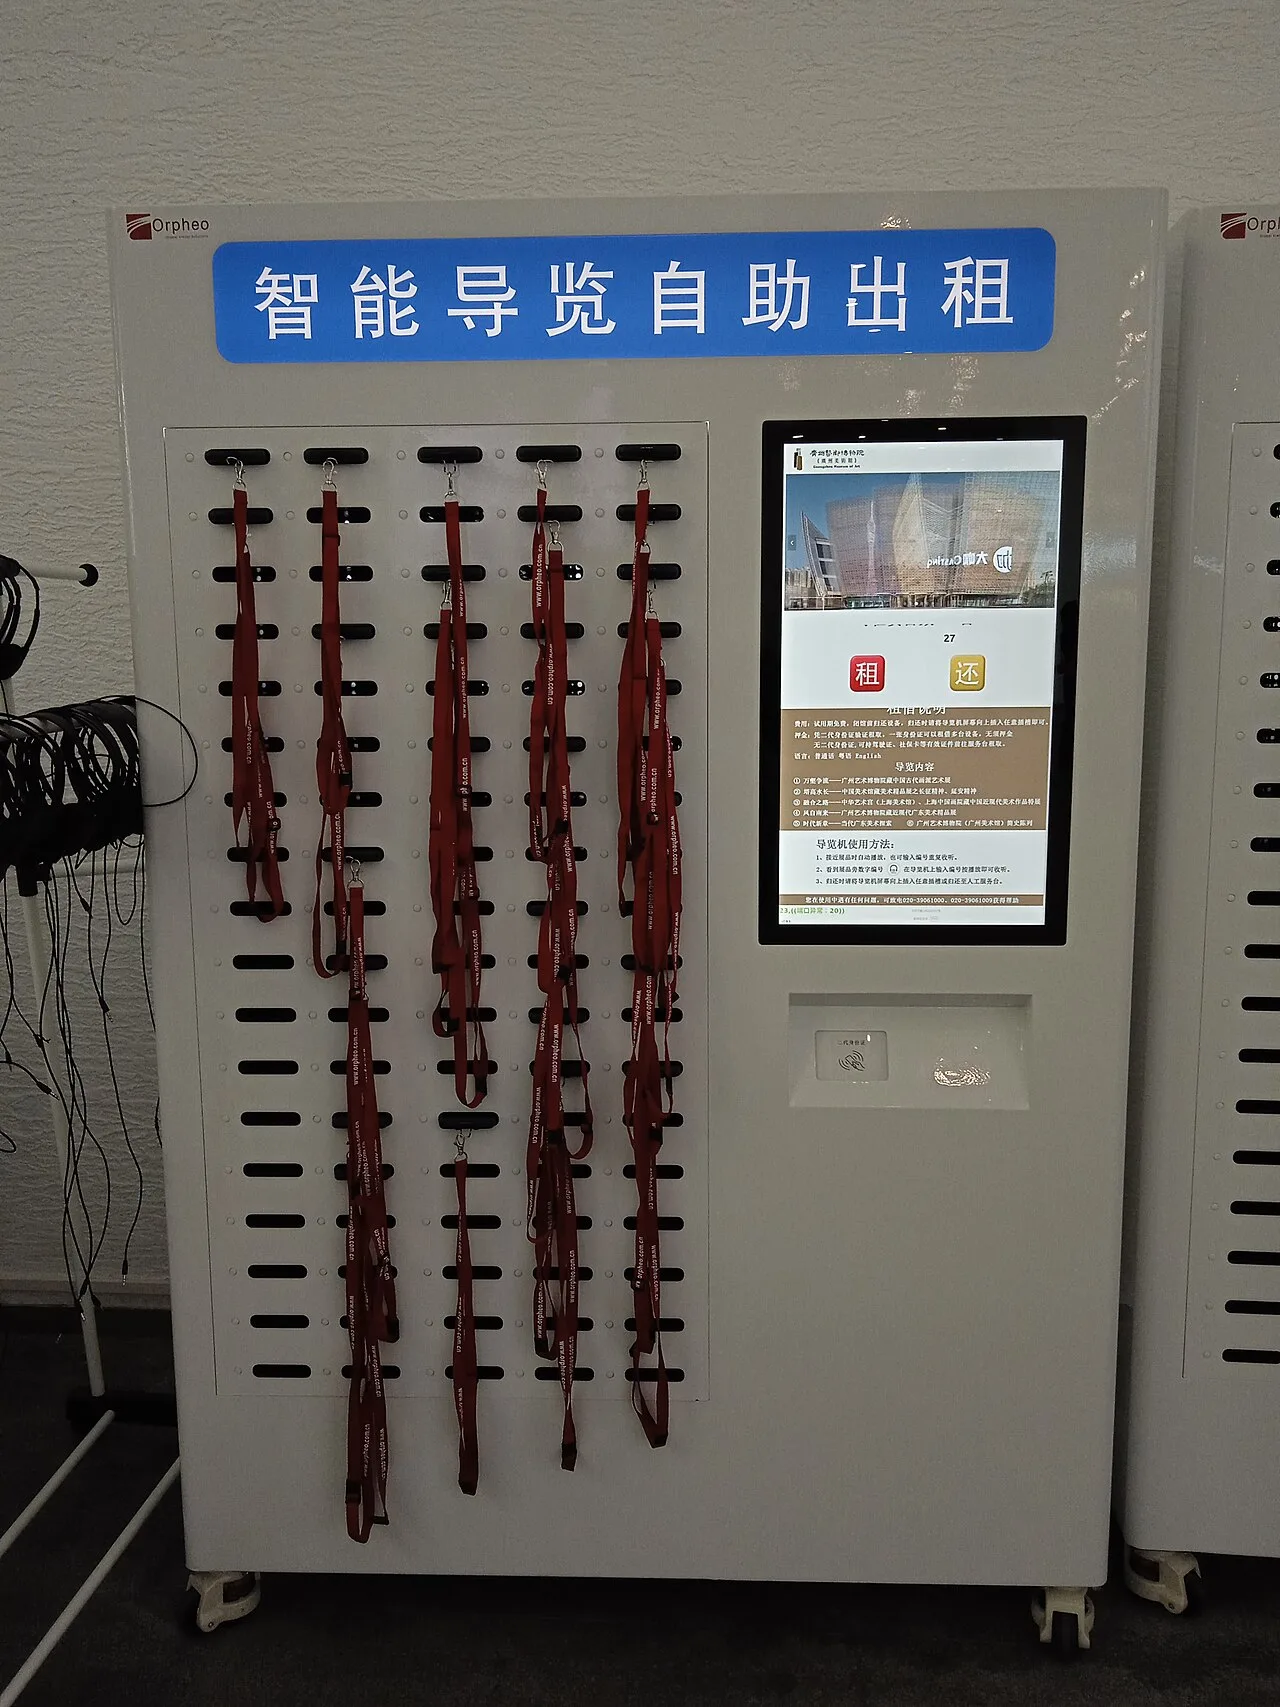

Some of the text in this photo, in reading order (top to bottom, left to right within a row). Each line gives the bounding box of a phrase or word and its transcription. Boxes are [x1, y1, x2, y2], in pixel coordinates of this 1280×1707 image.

[152, 217, 210, 235] Orpheo
[1246, 217, 1280, 234] Orp
[254, 256, 1014, 340] 智能导览自助出租
[943, 634, 955, 643] 27
[856, 661, 880, 687] 租
[955, 661, 980, 686] 还
[855, 752, 881, 760] English
[895, 761, 935, 772] 导览内容
[670, 816, 679, 874] www.orpheo.com.cn
[532, 1087, 542, 1143] www.orpheo.com.cn
